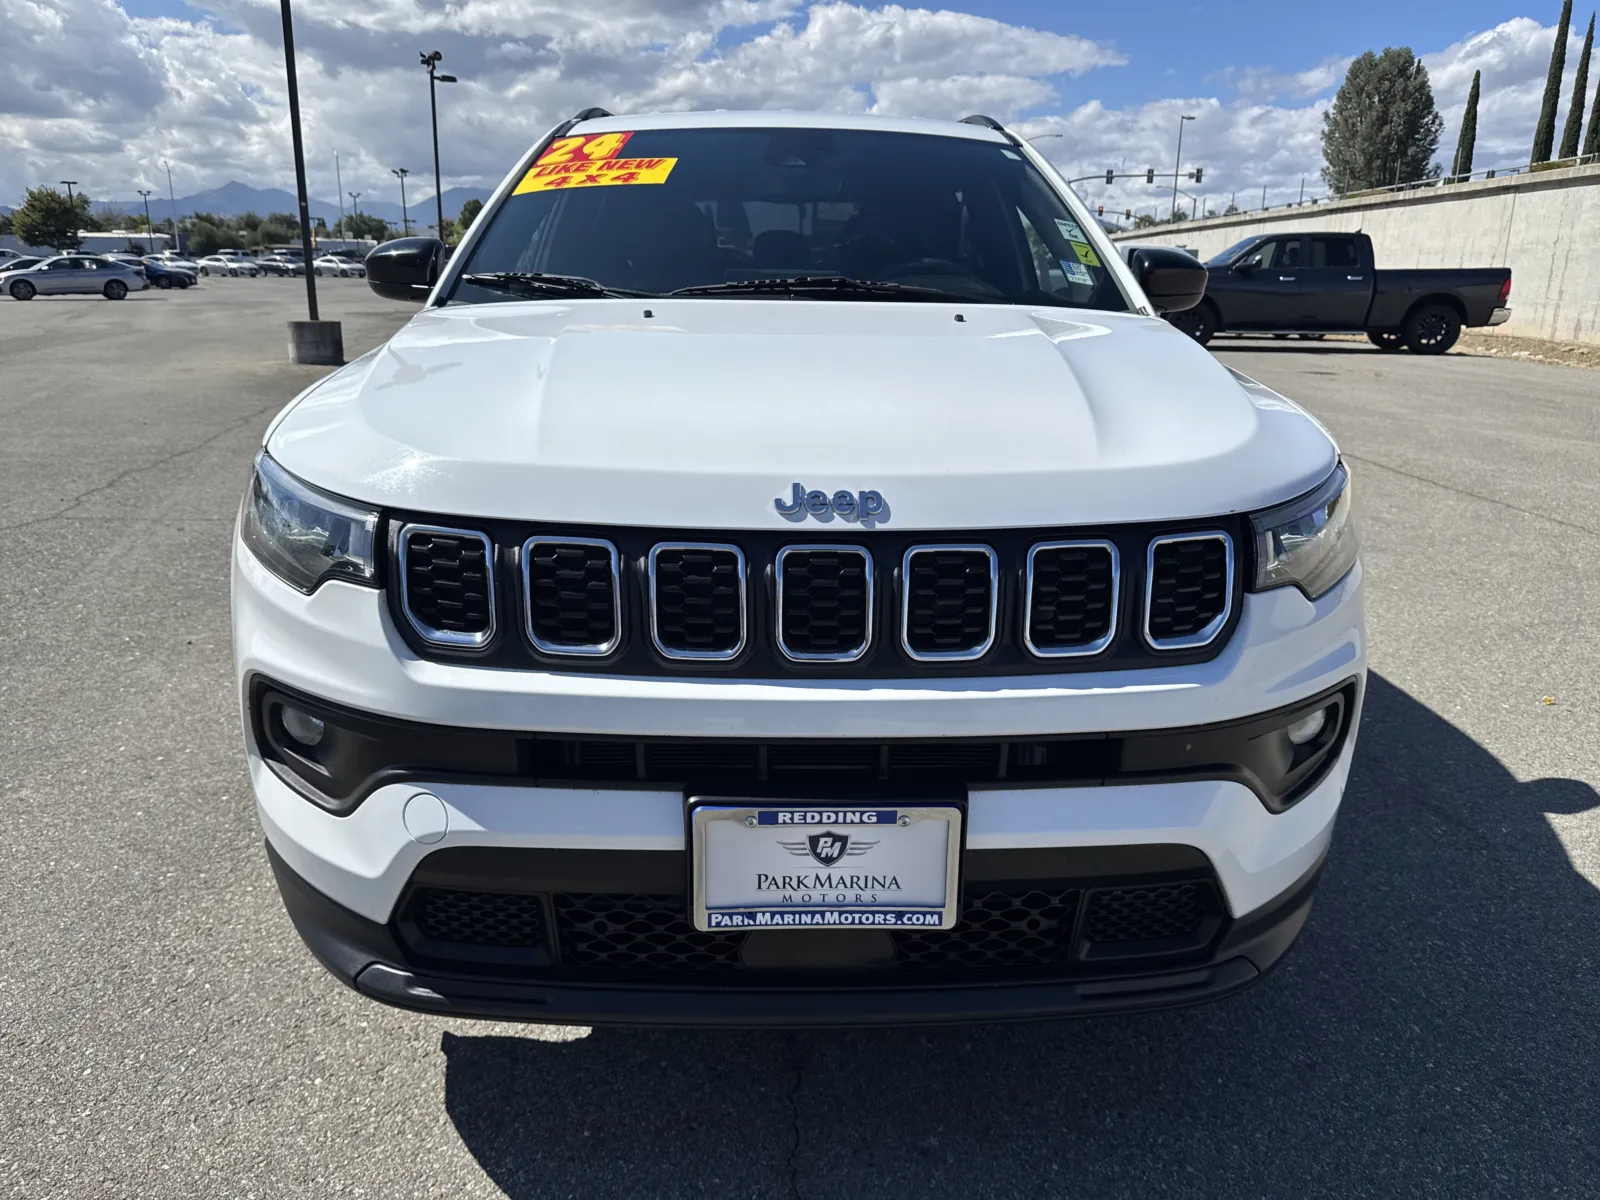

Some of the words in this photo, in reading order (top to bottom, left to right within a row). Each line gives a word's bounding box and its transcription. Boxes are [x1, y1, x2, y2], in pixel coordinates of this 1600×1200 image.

[537, 133, 626, 166] 24
[534, 161, 596, 176] LIKE
[597, 159, 666, 171] NEW
[774, 482, 884, 521] Jeep
[777, 811, 878, 824] REDDING
[781, 894, 878, 903] MOTORS
